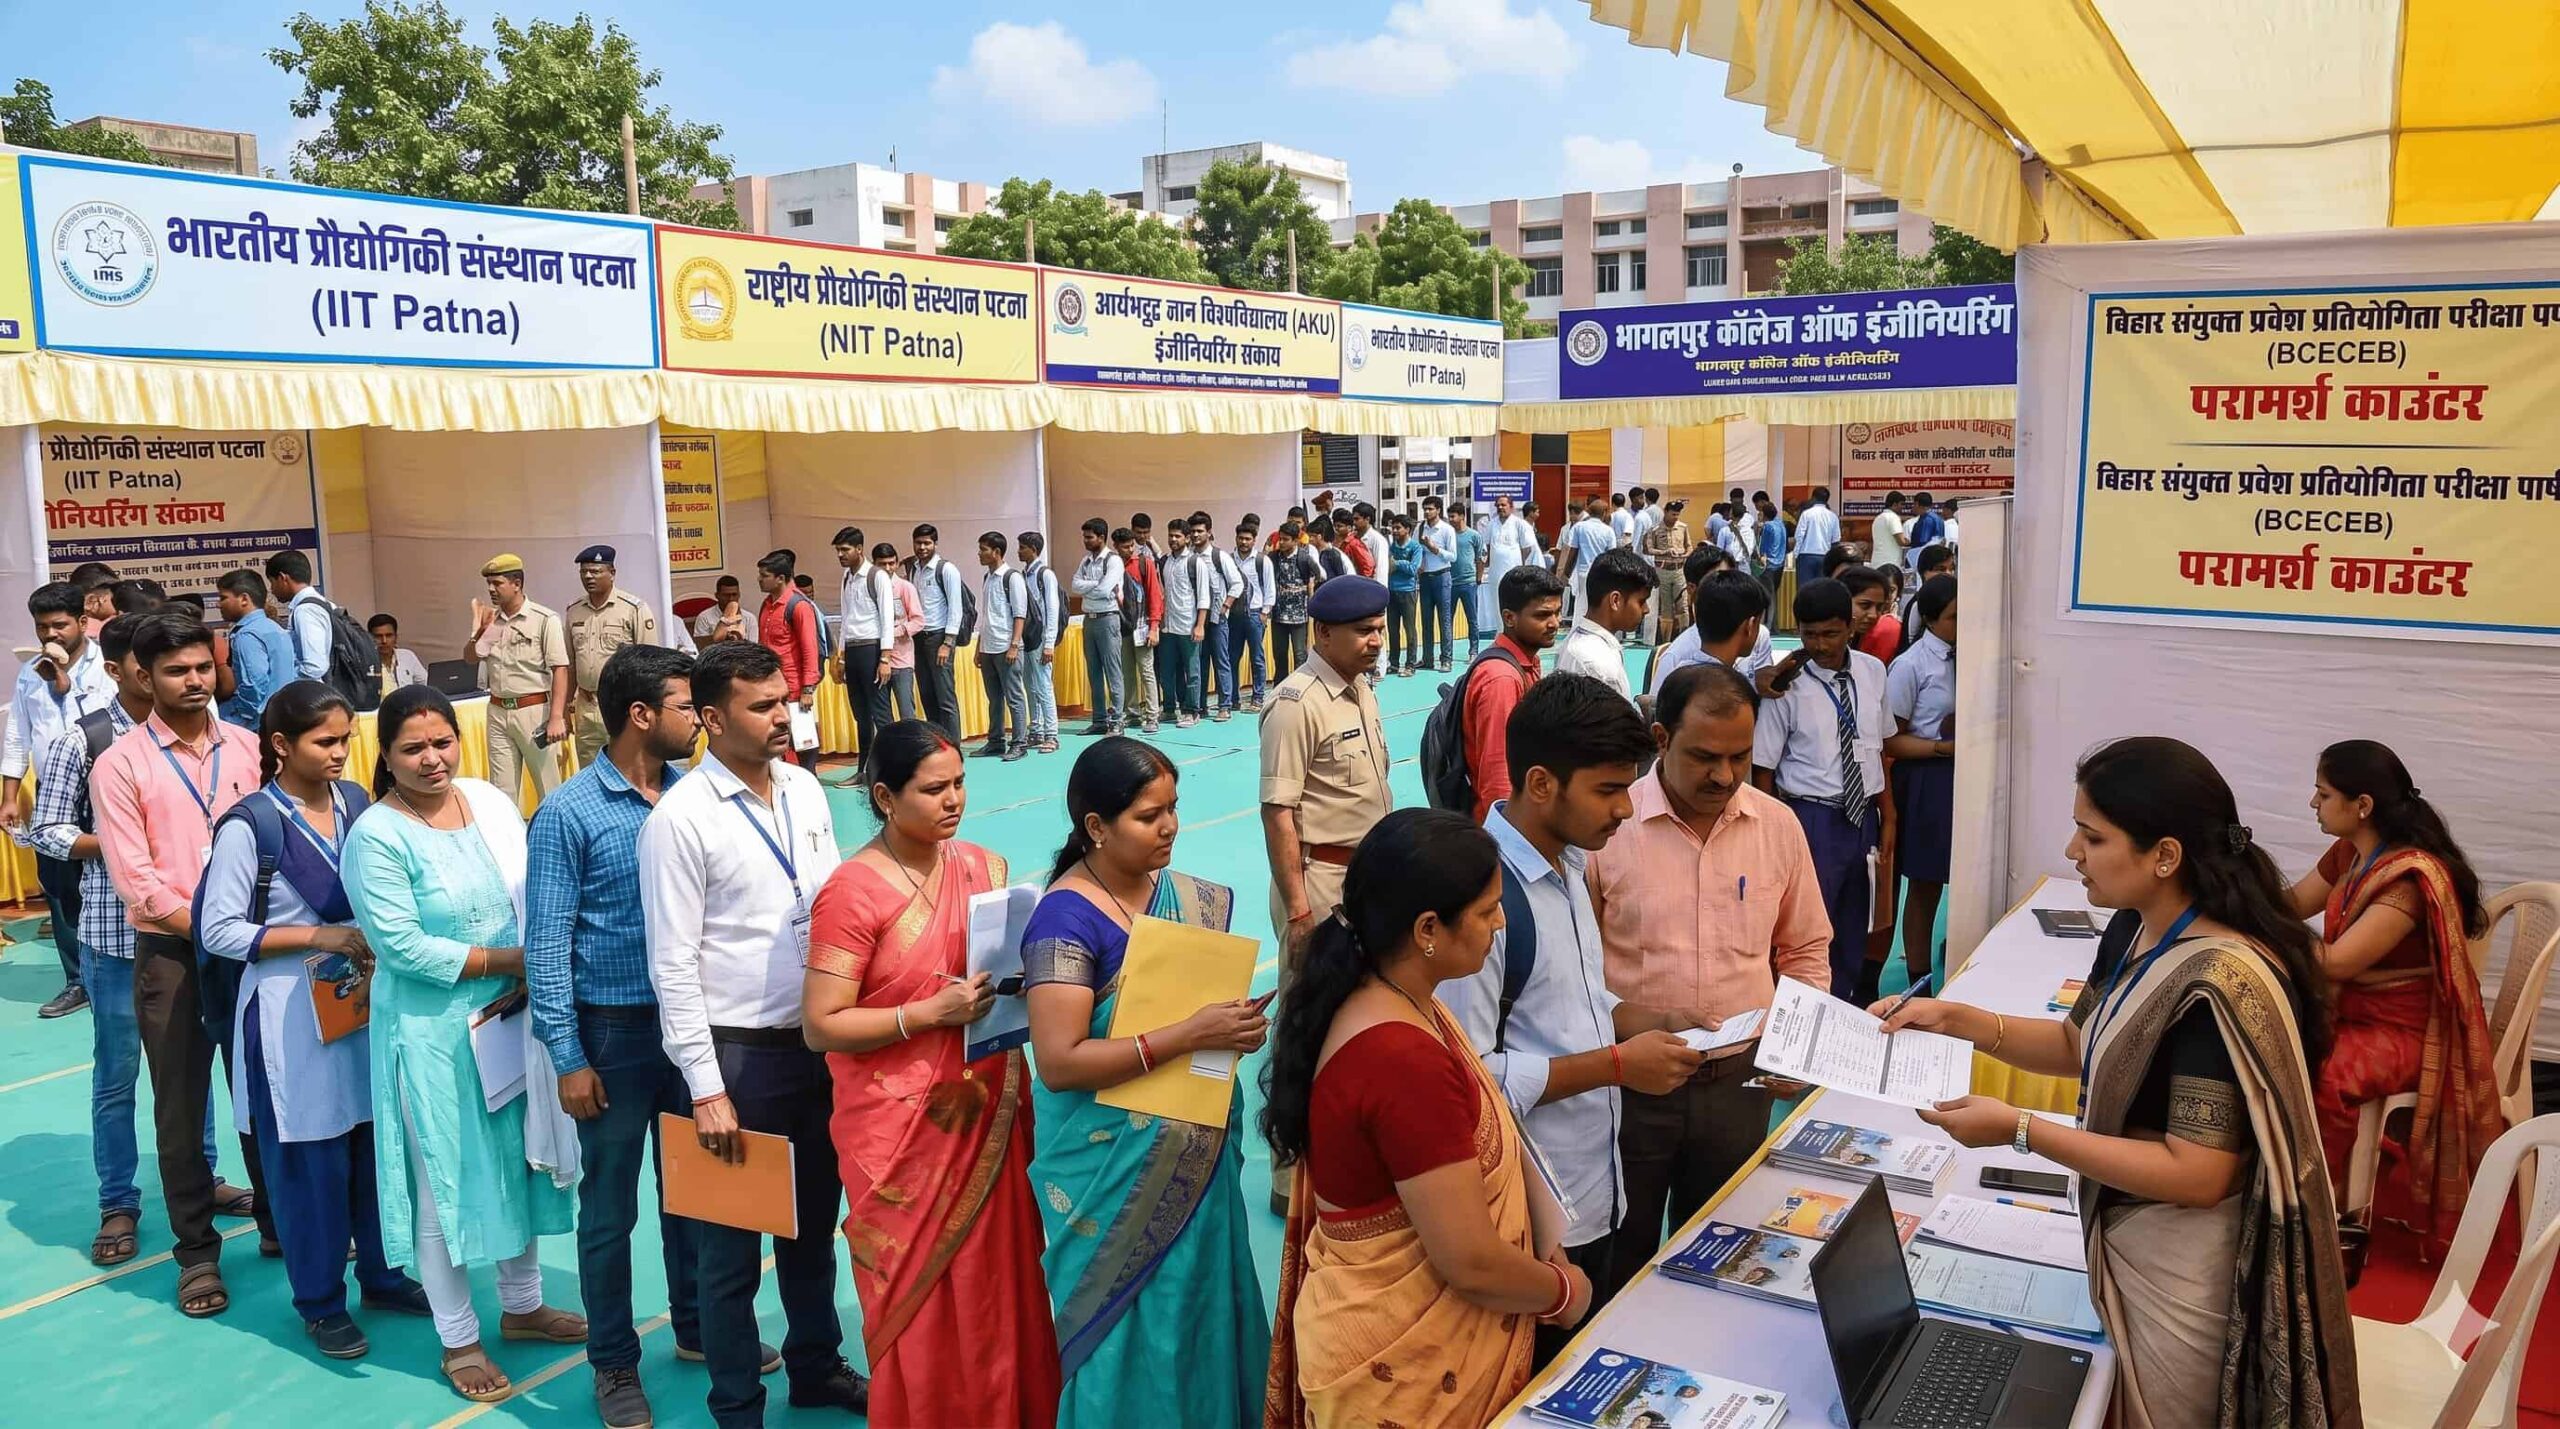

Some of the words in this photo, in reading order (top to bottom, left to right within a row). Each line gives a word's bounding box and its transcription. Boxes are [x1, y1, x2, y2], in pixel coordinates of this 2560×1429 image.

[167, 211, 299, 264] भारतीय
[305, 217, 450, 276] प्रौद्योगिकी
[456, 234, 563, 284] संस्थान
[569, 252, 636, 289] पटना
[745, 262, 810, 307] राष्ट्रीय
[815, 265, 907, 311] प्रौद्योगिकी
[912, 276, 980, 317] संस्थान
[984, 291, 1027, 320] पटना
[312, 288, 378, 336] (IIT
[393, 293, 520, 345] Patna)
[1292, 308, 1335, 343] (AKU)
[1616, 320, 1711, 359] भागलपुर
[1716, 309, 1795, 347] कॉलेज
[1801, 305, 1858, 343] ऑफ
[1865, 295, 2015, 344] इंजीनियरिंग
[2106, 307, 2165, 334] बिहार
[2171, 304, 2243, 340] संयुक्त
[2250, 302, 2306, 333] प्रवेश
[2313, 300, 2442, 331] प्रतियोगिता
[2449, 298, 2527, 328] परीक्षा
[820, 323, 875, 360] (NIT
[884, 327, 963, 366] Patna)
[1155, 330, 1237, 364] इंजीनियरिंग
[1241, 337, 1281, 367] संकाय
[1371, 325, 1406, 351] भारतीय
[1450, 333, 1478, 357] संस्थान
[1480, 340, 1501, 359] पटना
[2267, 340, 2406, 369] (BCECEB)
[1408, 364, 1426, 387] (IIT
[1430, 366, 1466, 391] Patna)
[2190, 373, 2333, 421] परामर्श
[2343, 371, 2489, 421] काउंटर
[47, 435, 141, 460] प्रौद्योगिकी
[143, 436, 216, 460] संस्थान
[218, 440, 265, 459] पटना
[65, 470, 100, 494] (IIT
[109, 469, 181, 491] Patna)
[2097, 461, 2156, 491] बिहार
[2161, 463, 2233, 500] संयुक्त
[2238, 464, 2294, 495] प्रवेश
[2300, 465, 2428, 498] प्रतियोगिता
[2433, 467, 2511, 500] परीक्षा
[154, 497, 225, 525] संकाय
[2254, 508, 2393, 540] (BCECEB)
[2178, 543, 2320, 590] परामर्श
[2330, 547, 2473, 597] काउंटर
